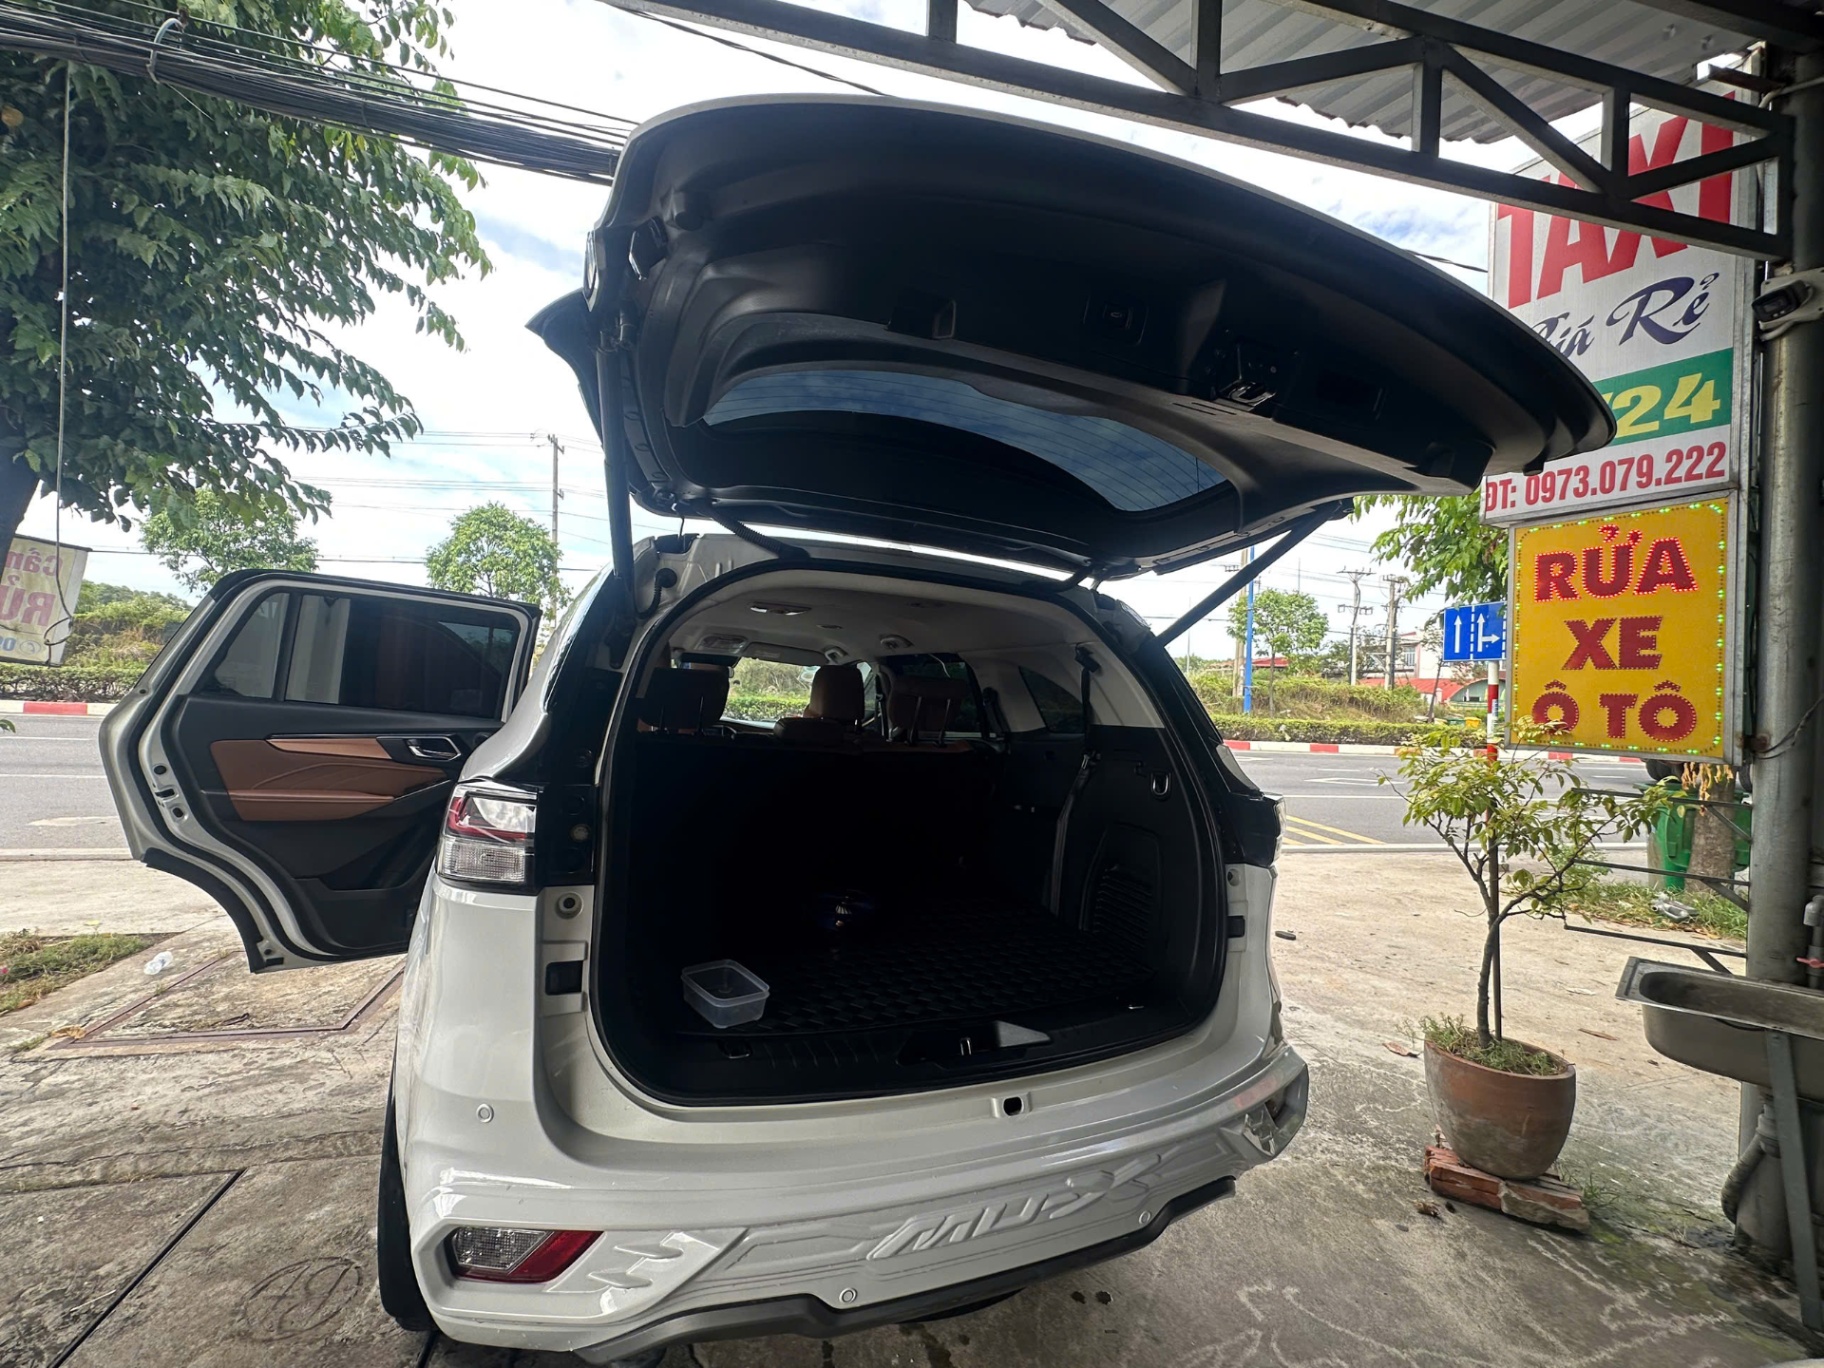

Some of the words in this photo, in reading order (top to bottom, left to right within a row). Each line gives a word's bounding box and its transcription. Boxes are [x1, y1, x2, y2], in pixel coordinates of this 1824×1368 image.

[1498, 90, 1736, 309] TAXI
[1606, 272, 1720, 345] Rẻ
[1525, 441, 1727, 506] 0973.079.222
[1533, 524, 1698, 602] RỬA
[1561, 615, 1663, 670] XE
[1532, 679, 1579, 735] Ô
[1599, 680, 1697, 742] TÔ
